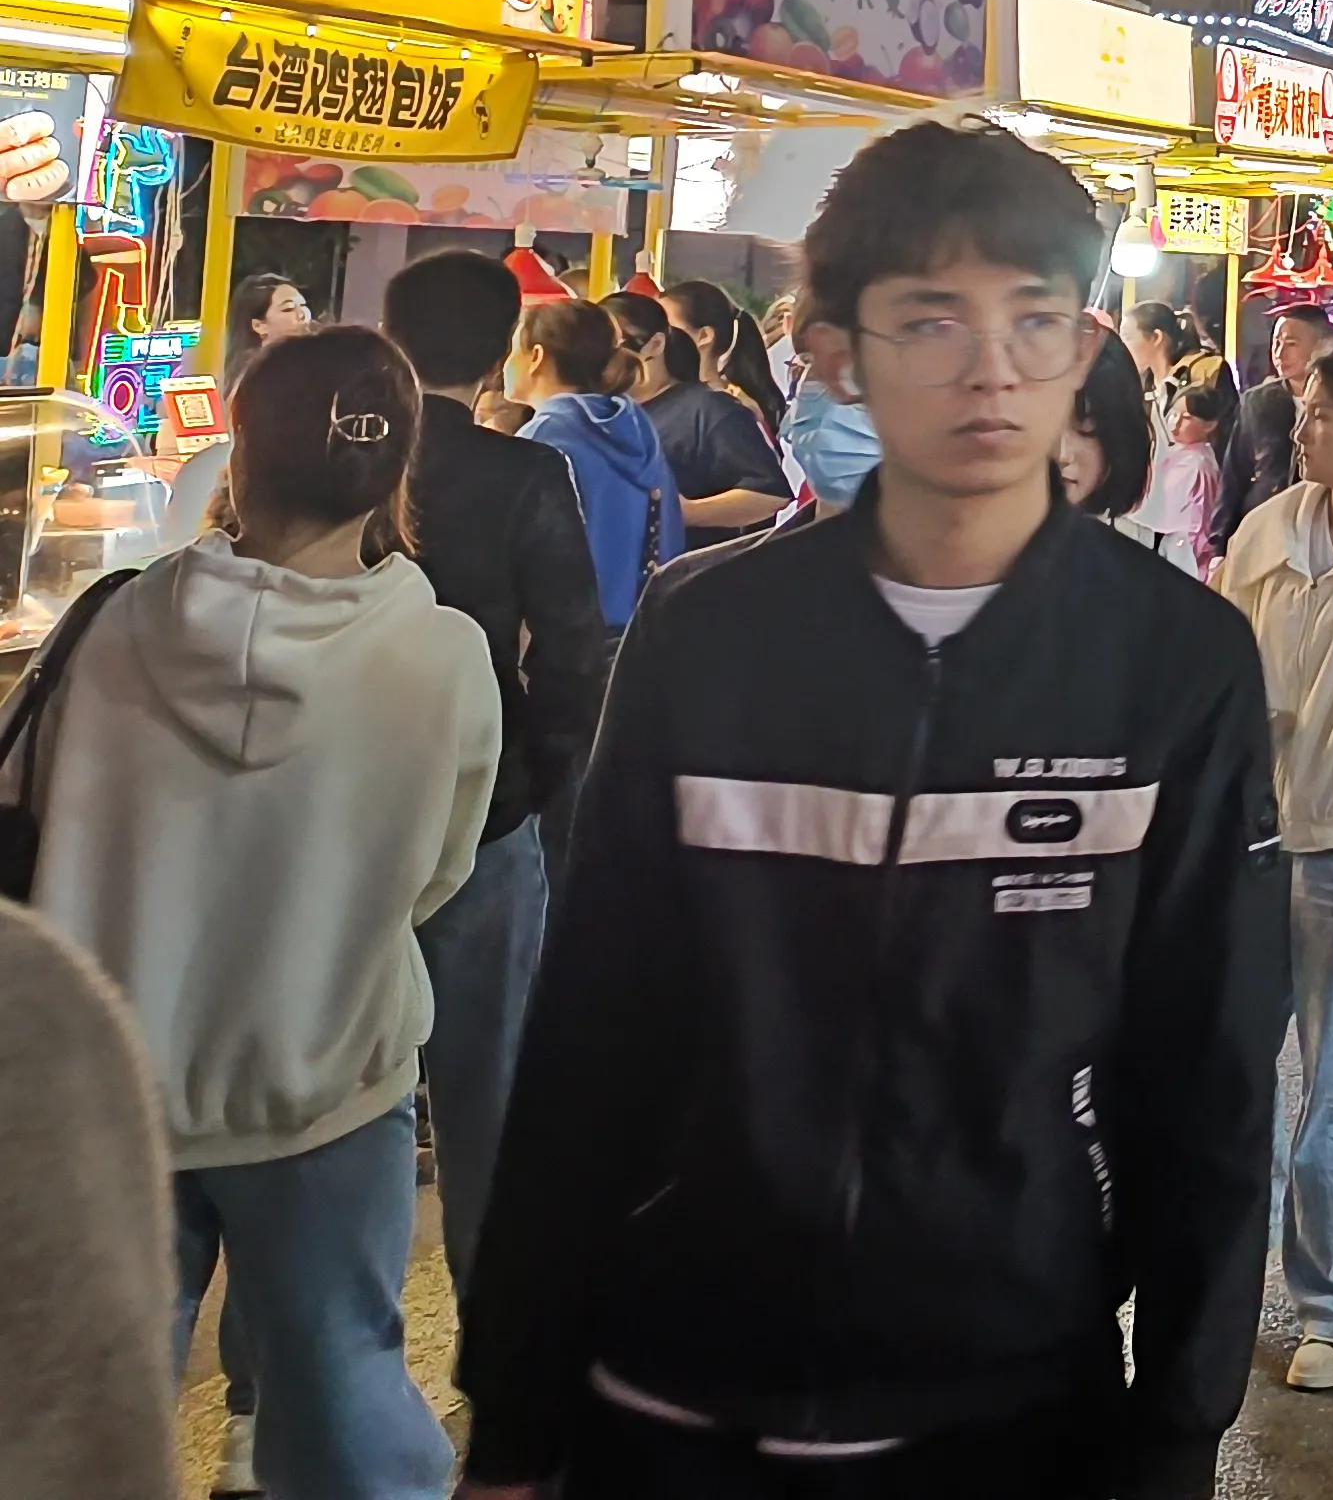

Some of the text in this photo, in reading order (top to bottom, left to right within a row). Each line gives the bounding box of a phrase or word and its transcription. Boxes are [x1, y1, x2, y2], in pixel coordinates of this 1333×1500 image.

[212, 30, 466, 133] 台湾鸡翅包饭
